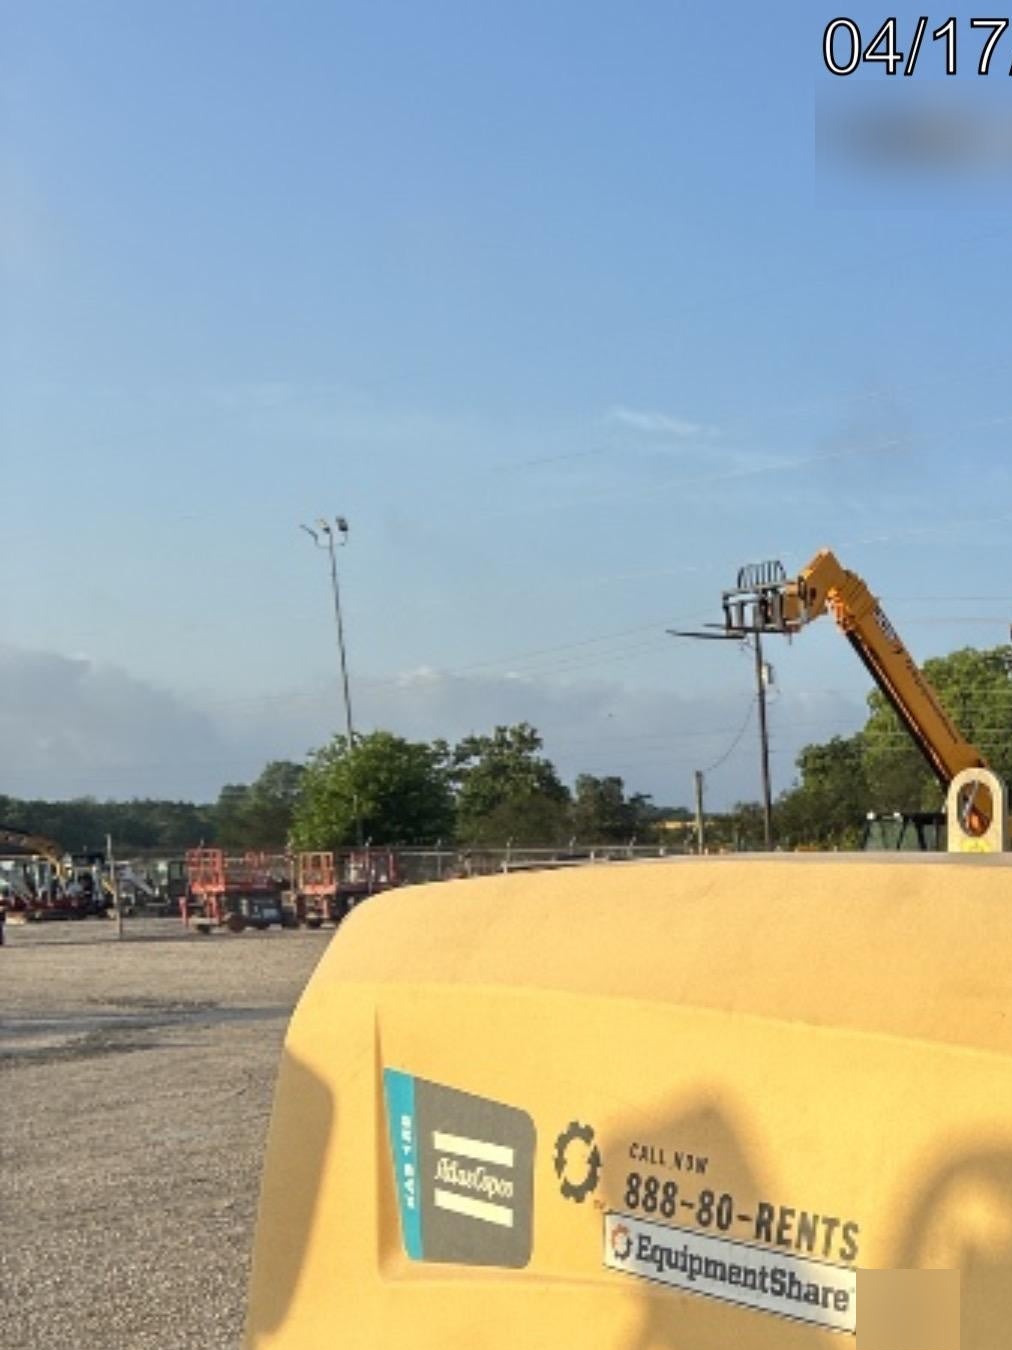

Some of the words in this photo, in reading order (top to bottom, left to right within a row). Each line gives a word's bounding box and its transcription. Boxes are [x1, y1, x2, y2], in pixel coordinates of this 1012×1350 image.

[629, 1142, 665, 1165] CALL
[673, 1151, 710, 1174] NOW
[625, 1172, 860, 1262] 888-80-RENTS
[636, 1234, 850, 1312] EquipmentShare
